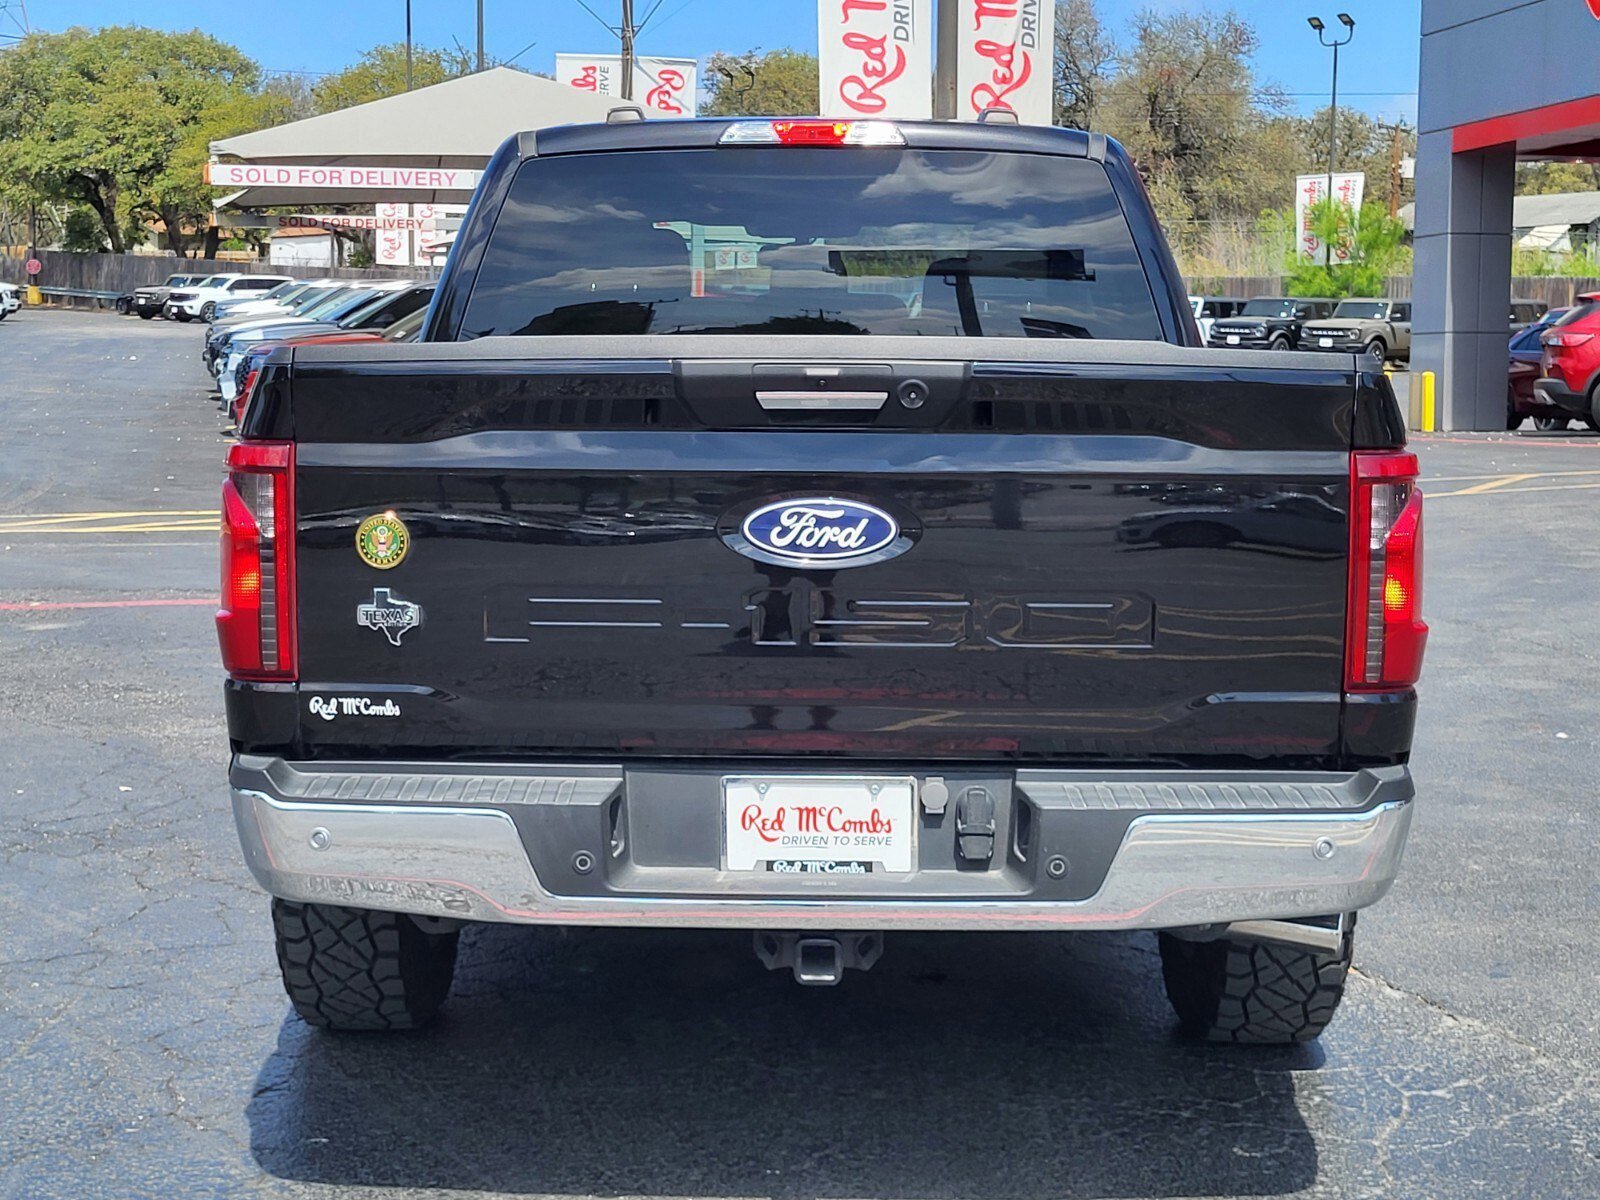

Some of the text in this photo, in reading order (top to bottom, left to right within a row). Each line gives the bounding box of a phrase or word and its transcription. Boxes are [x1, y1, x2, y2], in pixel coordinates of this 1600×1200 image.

[840, 32, 906, 114] Red
[971, 40, 1031, 114] Red
[646, 69, 685, 114] Red
[230, 168, 458, 187] SOLD FOR DELIVERY
[279, 216, 425, 230] SOLD FOR DELIVERY
[770, 507, 869, 549] Ford
[362, 609, 414, 622] TEXAS
[309, 696, 401, 720] Red McCombs
[741, 804, 893, 842] Red McCombs
[782, 835, 893, 846] DRIVEN TO SERVE
[773, 860, 865, 873] Red McCombs
